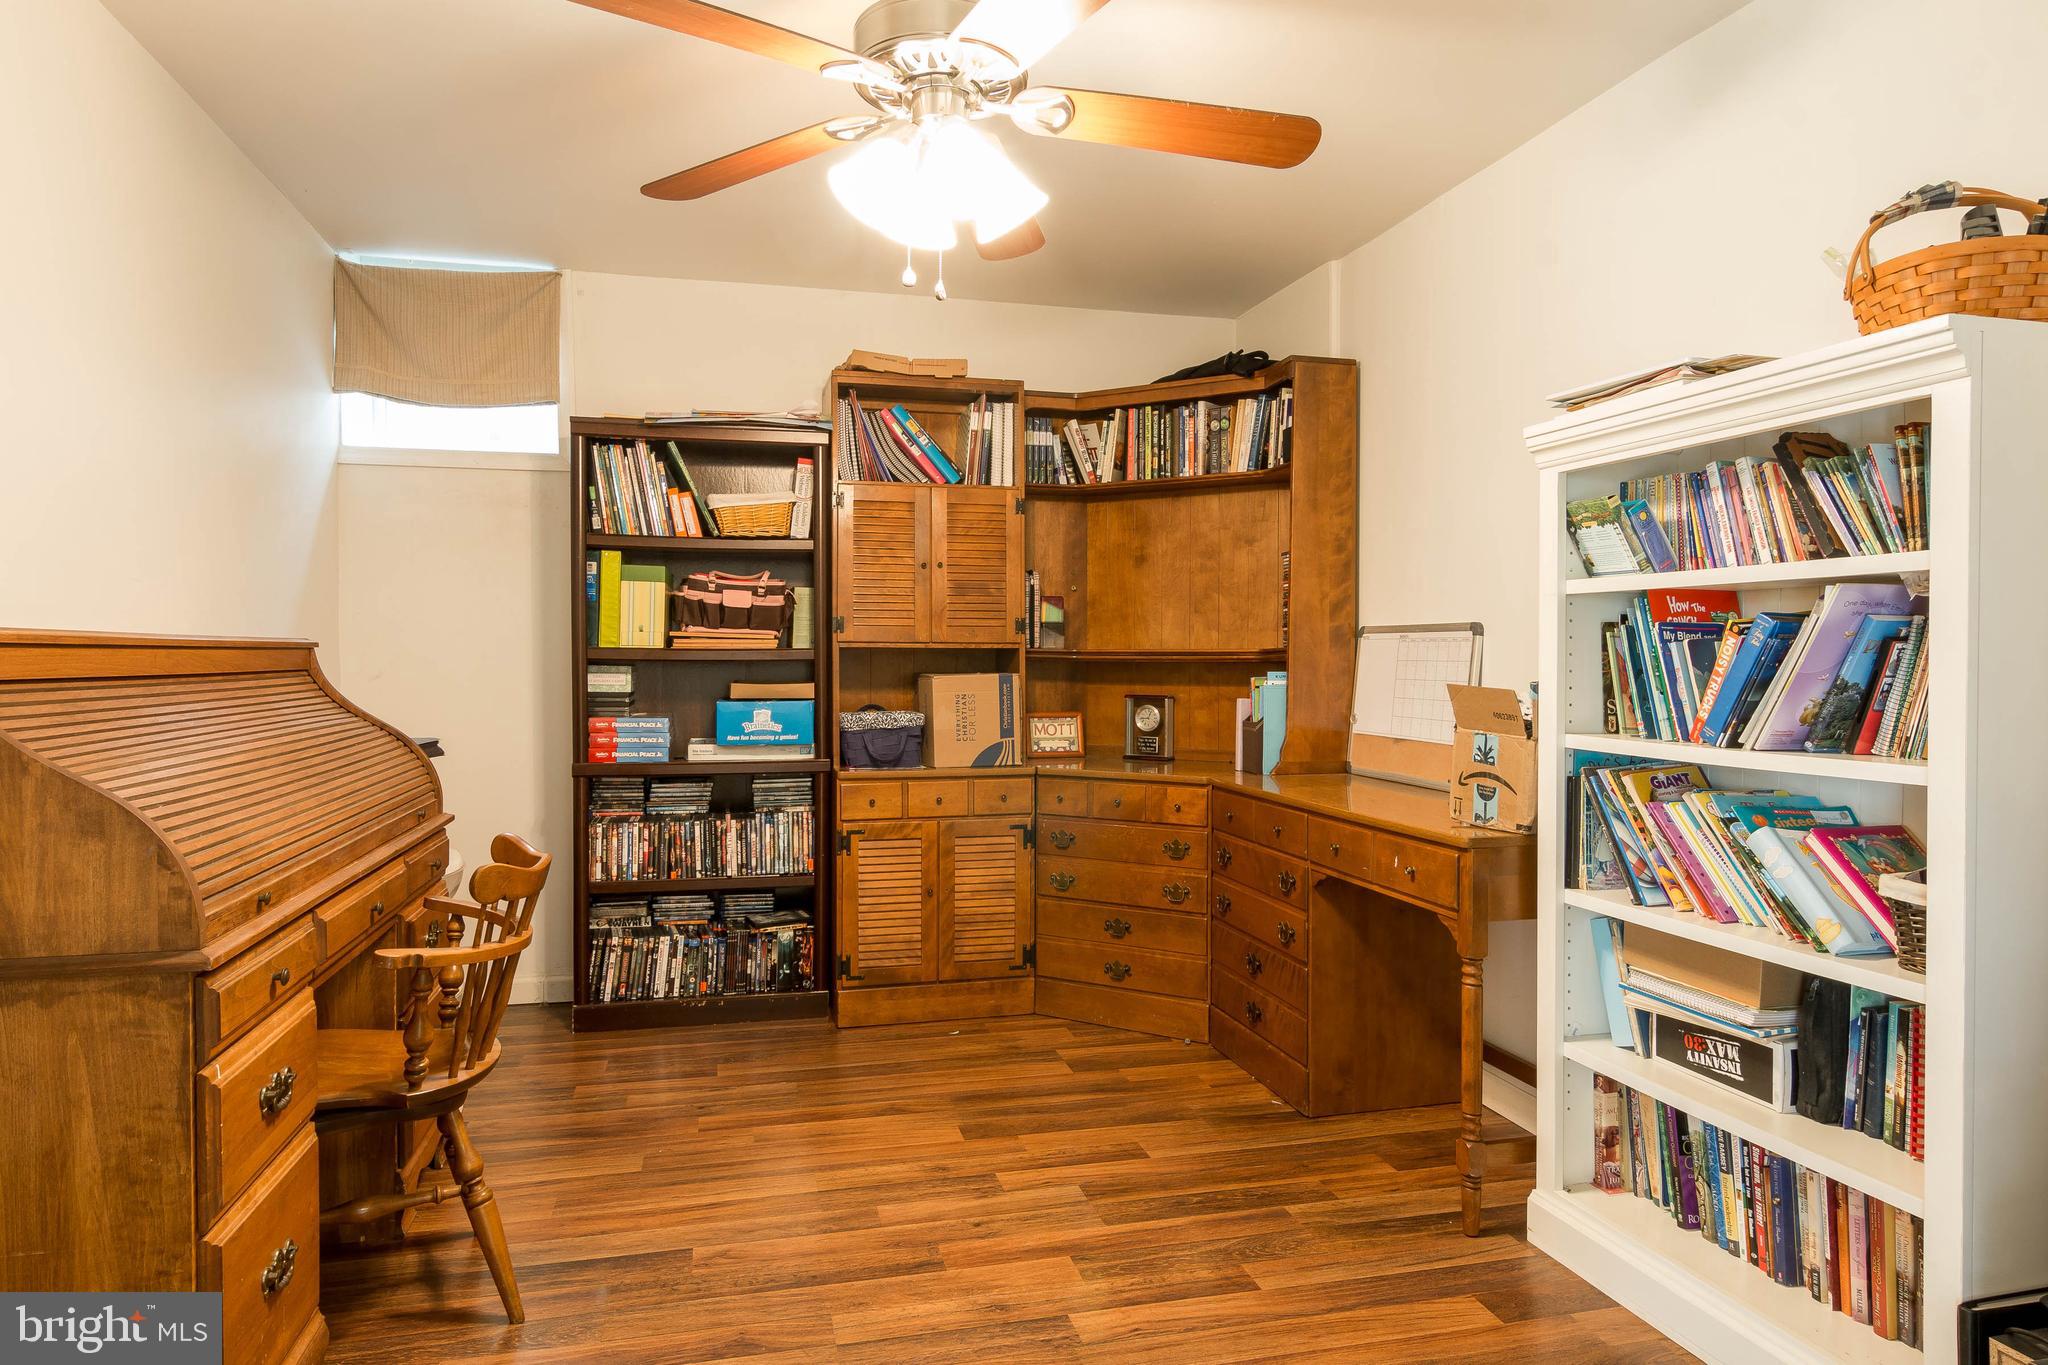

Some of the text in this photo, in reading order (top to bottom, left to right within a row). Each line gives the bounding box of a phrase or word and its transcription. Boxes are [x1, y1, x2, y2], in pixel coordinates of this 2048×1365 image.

[1080, 448, 1090, 465] SELLING
[1666, 595, 1706, 613] How The
[1843, 600, 1859, 608] One
[1663, 632, 1675, 641] My
[1699, 634, 1737, 721] NOISY TRUCKS
[967, 693, 976, 741] FOR LESS
[742, 722, 783, 732] Brainetics
[1034, 723, 1074, 737] MOTT
[779, 734, 799, 742] genius!
[1684, 1034, 1741, 1062] MAX:30
[1686, 1050, 1742, 1076] INSANITY
[1894, 1054, 1903, 1088] HARBINGER
[1752, 1146, 1760, 1163] Slow
[1716, 1129, 1733, 1236] AVE RAMSEY EntreLeadership
[1755, 1200, 1763, 1227] Faster!
